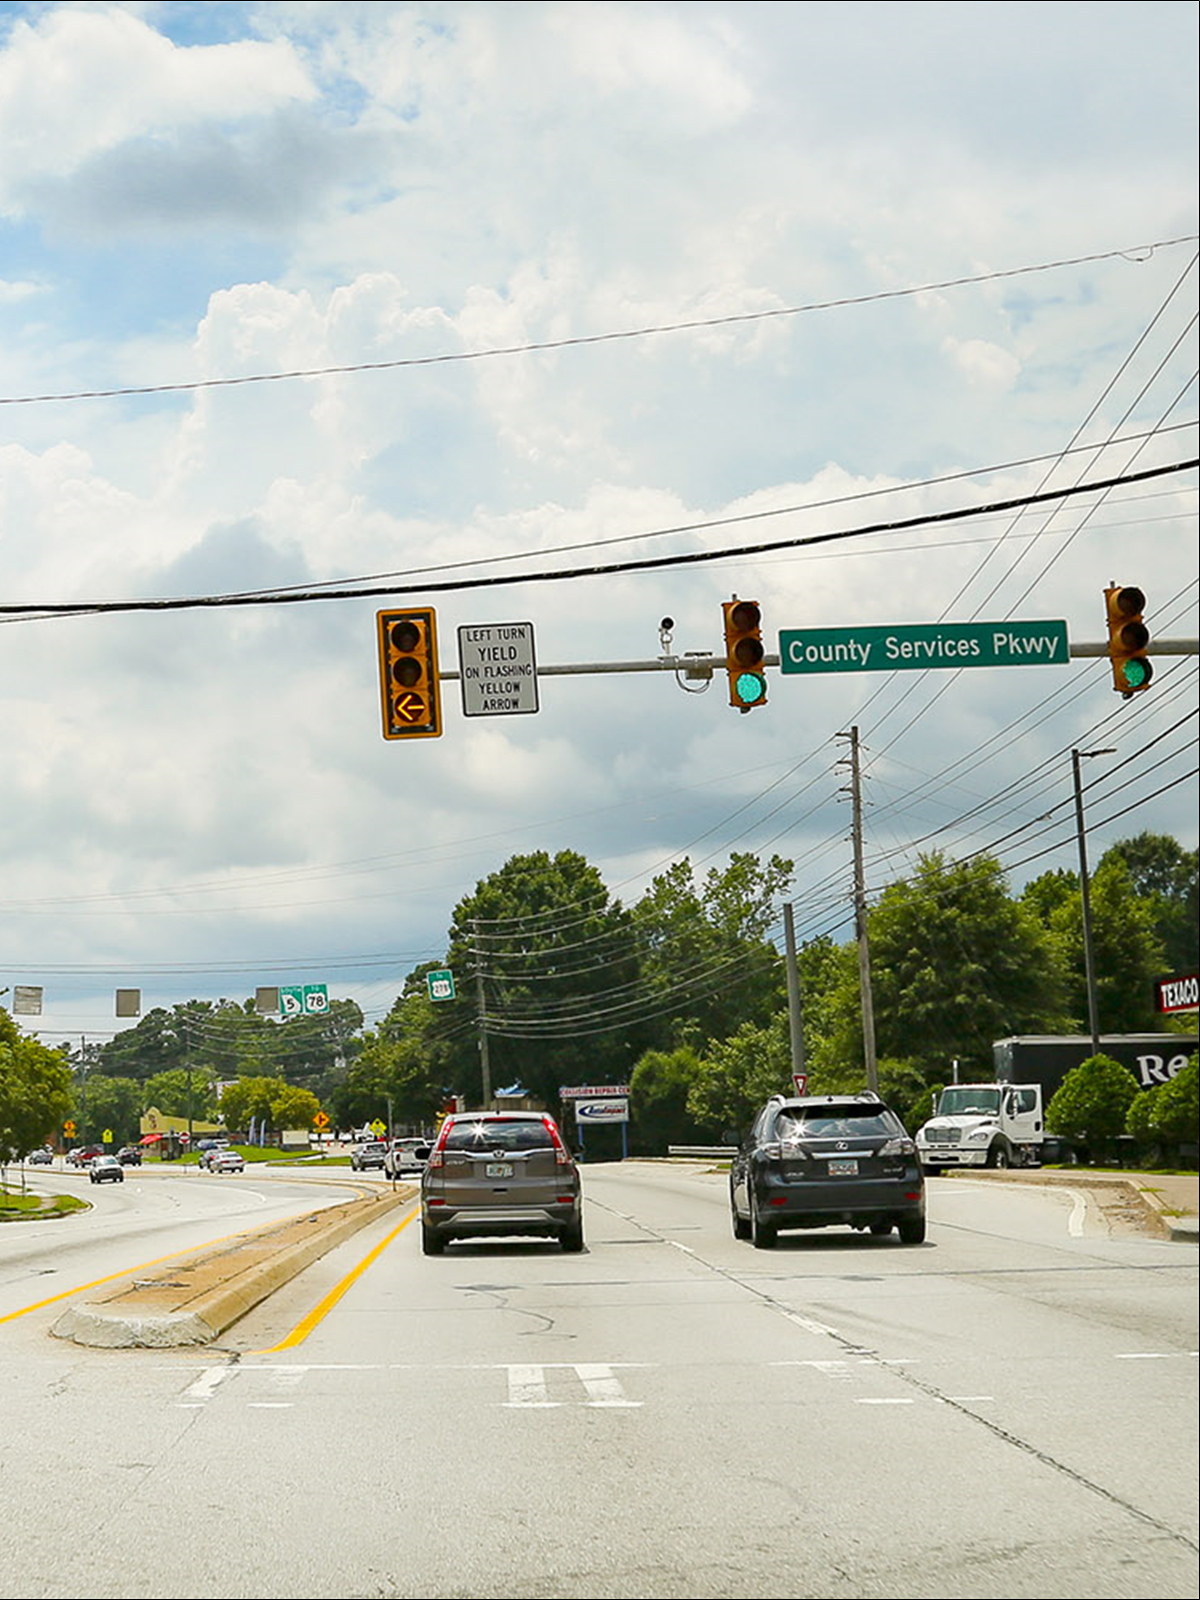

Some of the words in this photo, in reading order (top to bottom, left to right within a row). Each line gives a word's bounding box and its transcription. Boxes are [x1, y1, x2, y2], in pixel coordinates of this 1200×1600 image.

[466, 629, 491, 642] LEFT
[497, 627, 525, 640] TURN
[478, 646, 517, 661] YIELD
[788, 639, 871, 665] County
[885, 635, 980, 660] Services
[993, 632, 1059, 658] Pkwy
[465, 667, 479, 679] ON
[484, 664, 532, 678] FLASHING
[479, 681, 521, 695] YELLOW
[482, 698, 519, 711] ARROW
[1161, 977, 1199, 1008] TEXACO
[286, 999, 295, 1010] 5
[308, 995, 324, 1007] 78
[1136, 1054, 1189, 1085] Re
